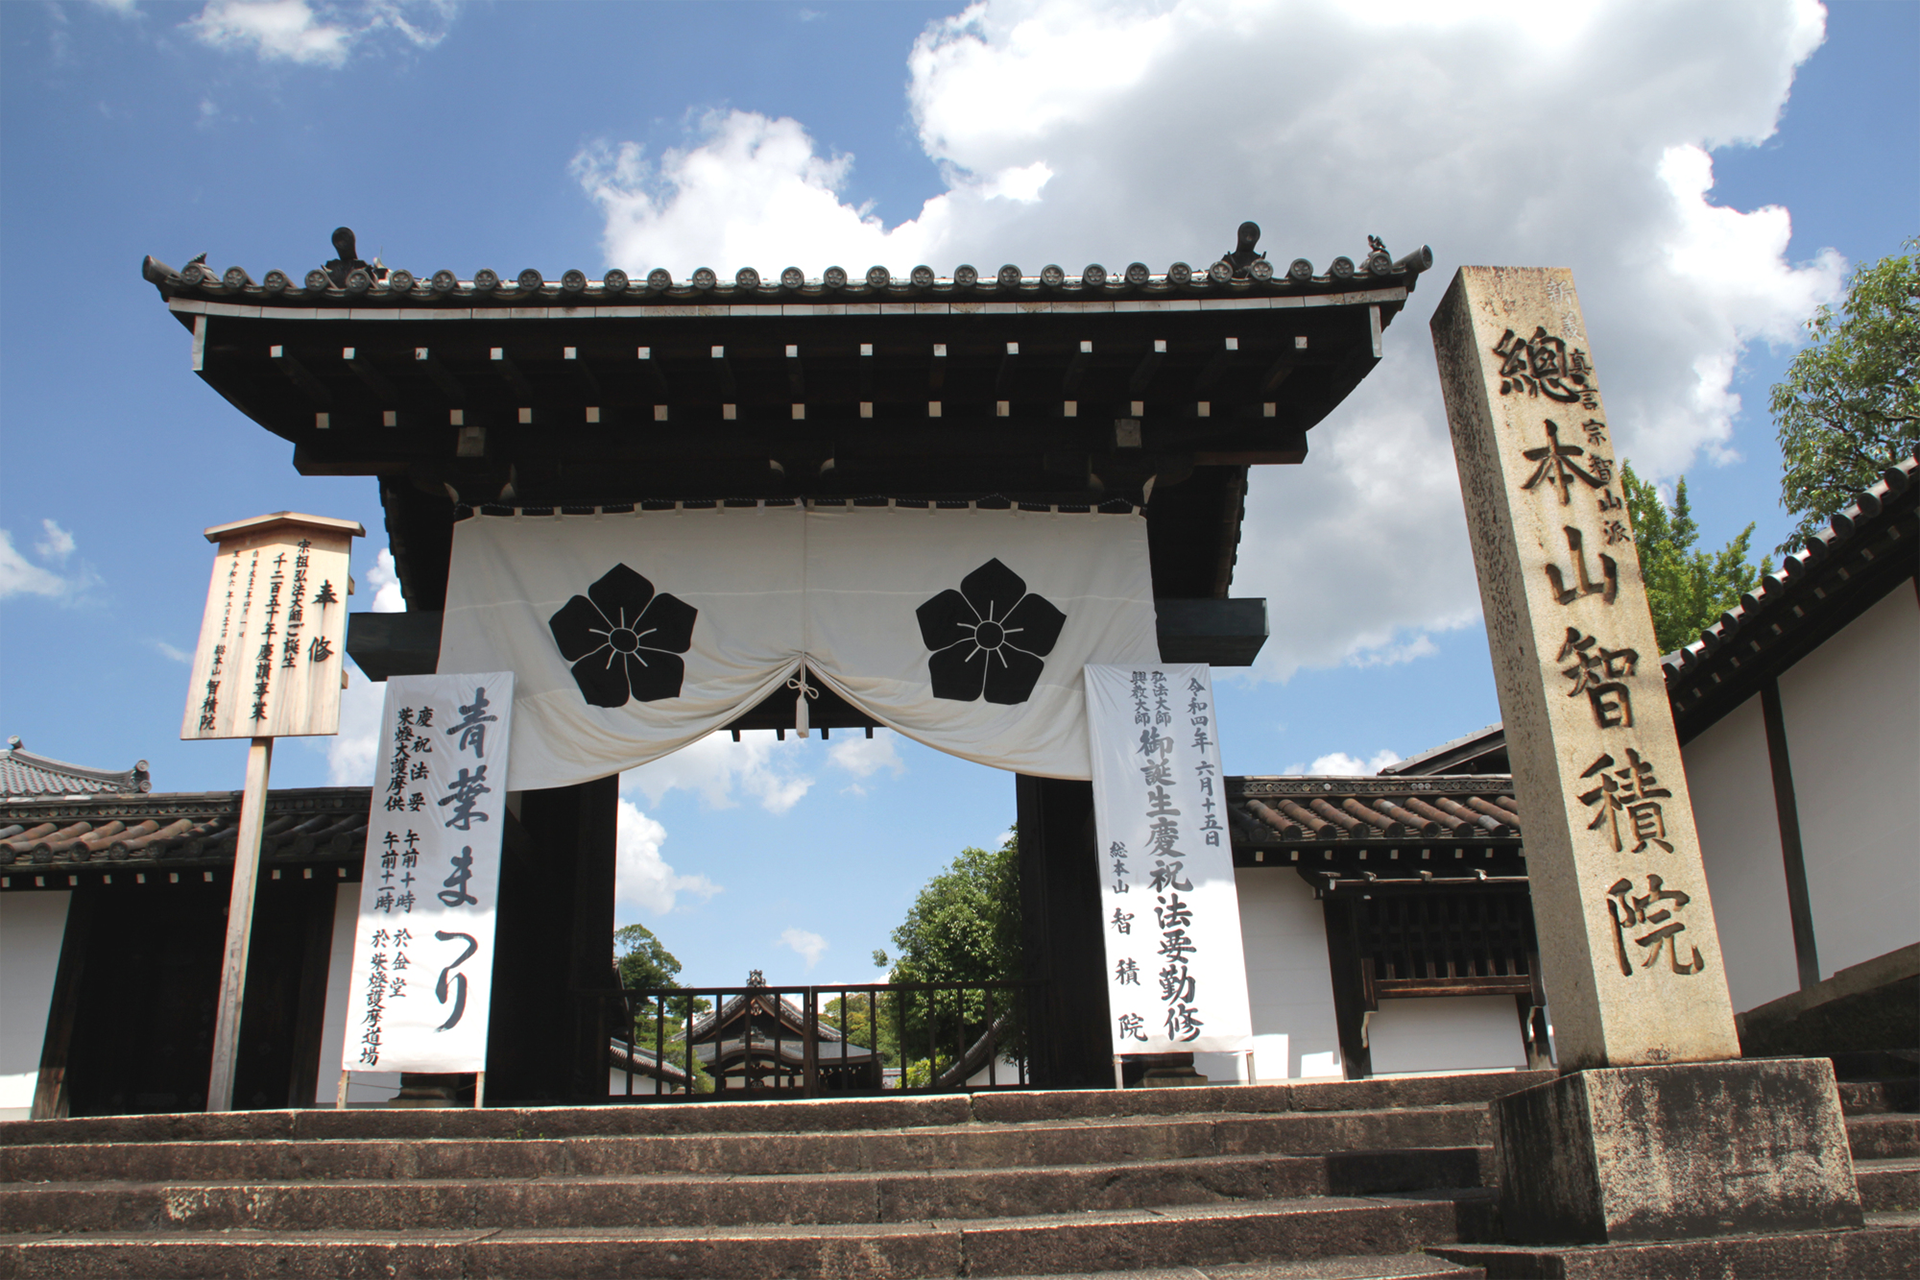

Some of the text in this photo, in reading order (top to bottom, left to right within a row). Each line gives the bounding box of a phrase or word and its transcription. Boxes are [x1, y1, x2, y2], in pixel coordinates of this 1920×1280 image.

[282, 538, 312, 669] 宗祖弘法大師ご誕生
[1492, 326, 1704, 976] 總本山智積院
[1129, 671, 1151, 727] 興教大師
[1151, 671, 1172, 727] 弘法大師
[1187, 678, 1223, 847] 令和四年六月十五日
[374, 831, 400, 914] 午前十一時
[389, 706, 434, 998] 慶祝法要 午前十時 於金堂
[433, 687, 498, 1033] 青葉まつり
[1135, 726, 1204, 1042] 御誕生慶祝法要勤修
